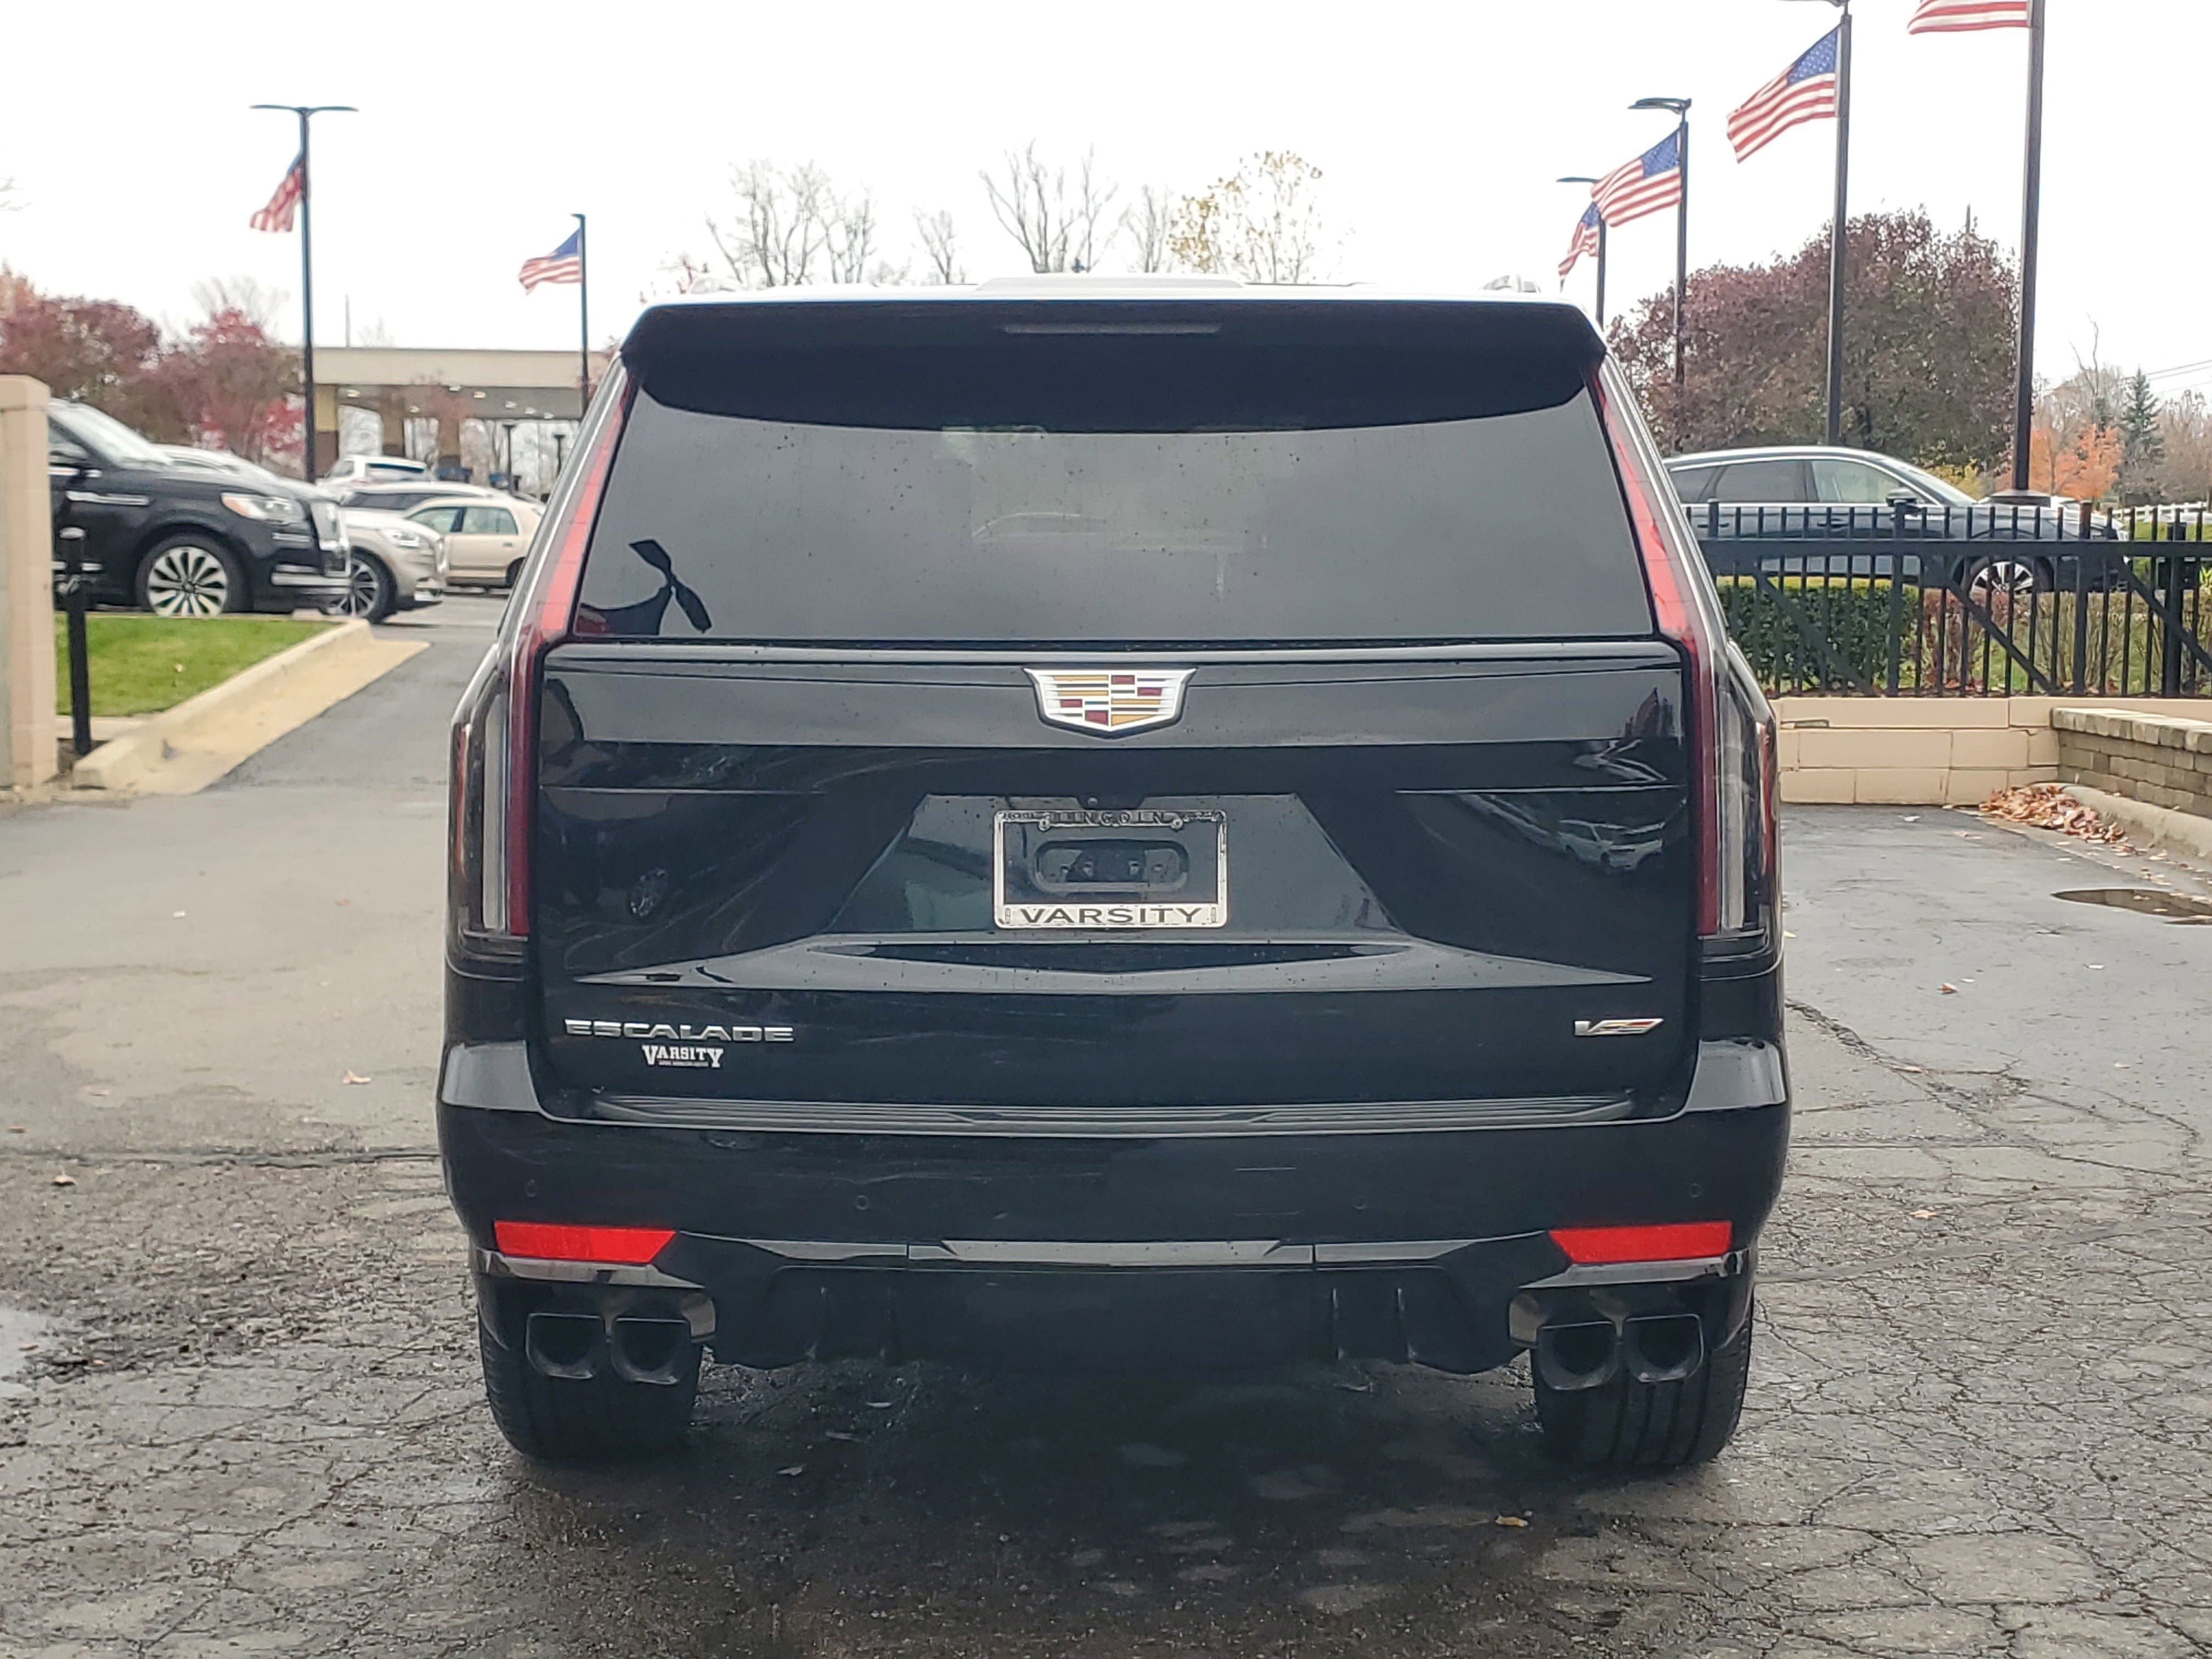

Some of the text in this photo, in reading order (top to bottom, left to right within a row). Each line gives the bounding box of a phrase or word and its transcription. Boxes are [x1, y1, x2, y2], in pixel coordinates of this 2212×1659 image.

[1021, 907, 1203, 923] VARSITY
[565, 1019, 794, 1042] ESCALADE
[641, 1045, 724, 1068] VARSITY
